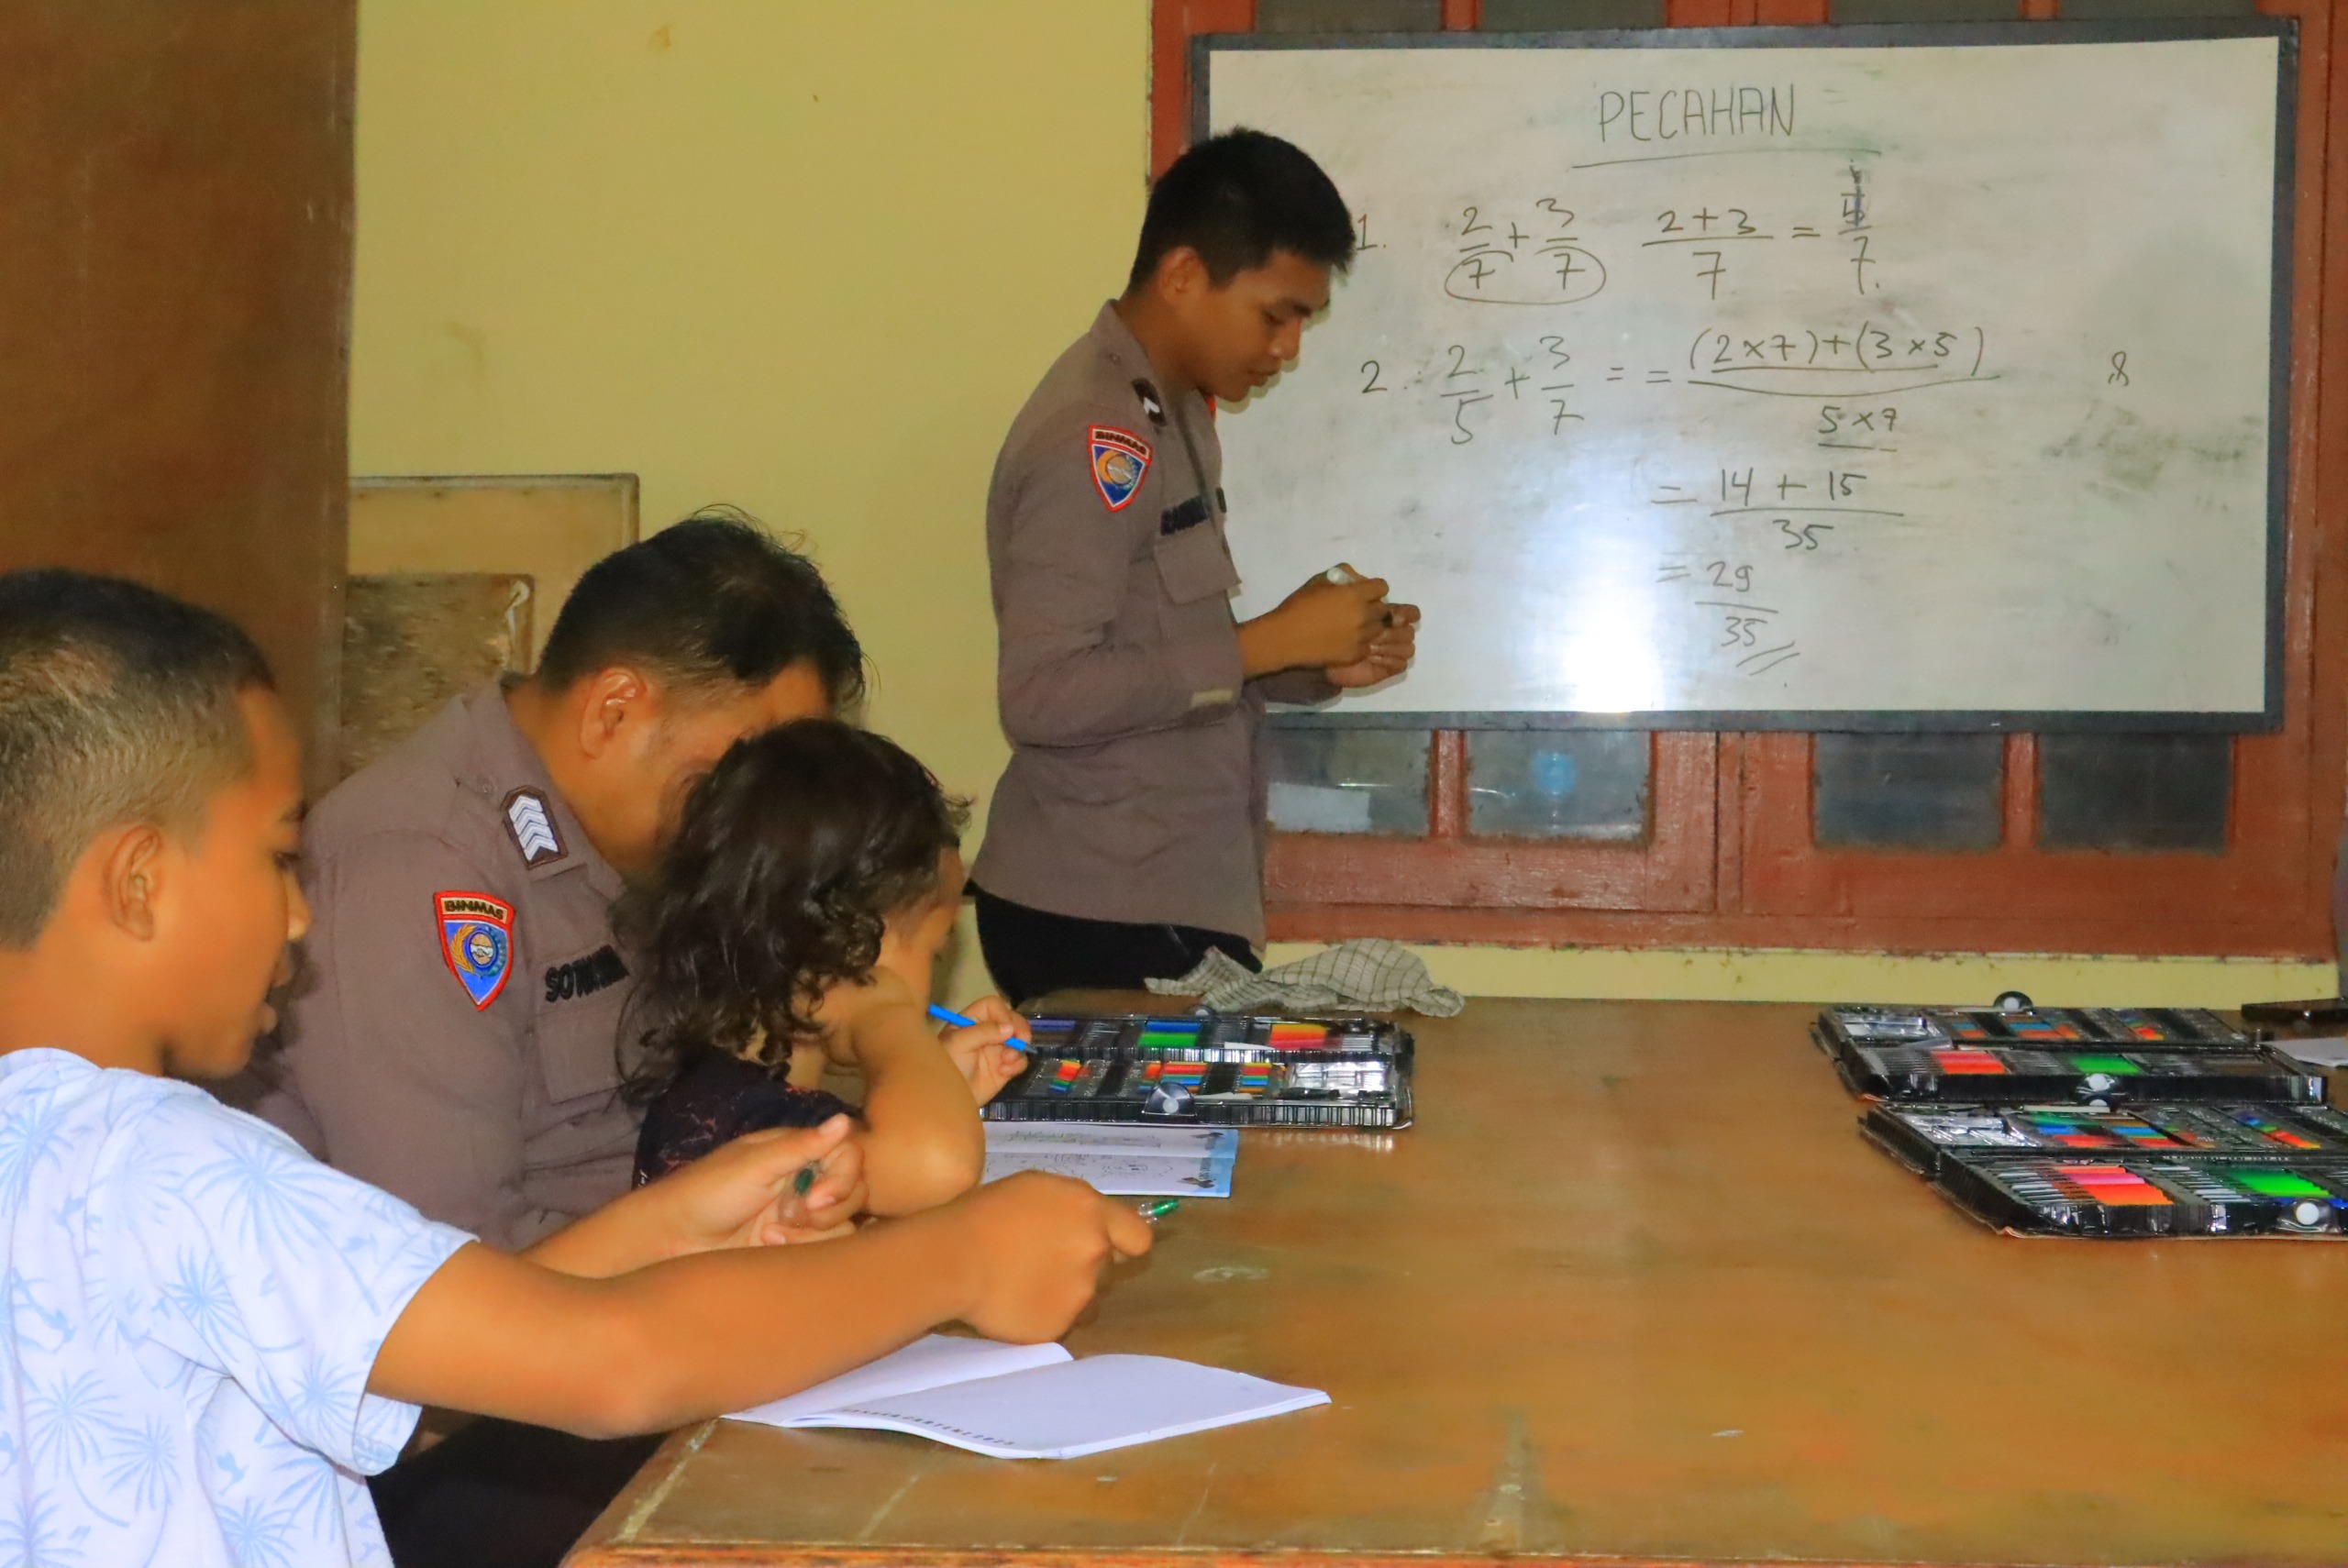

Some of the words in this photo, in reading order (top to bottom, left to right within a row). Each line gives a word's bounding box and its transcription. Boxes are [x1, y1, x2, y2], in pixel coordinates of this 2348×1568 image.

[1600, 83, 1794, 143] PECAHAN
[1772, 519, 1834, 550] 35
[444, 900, 504, 921] BINMAS
